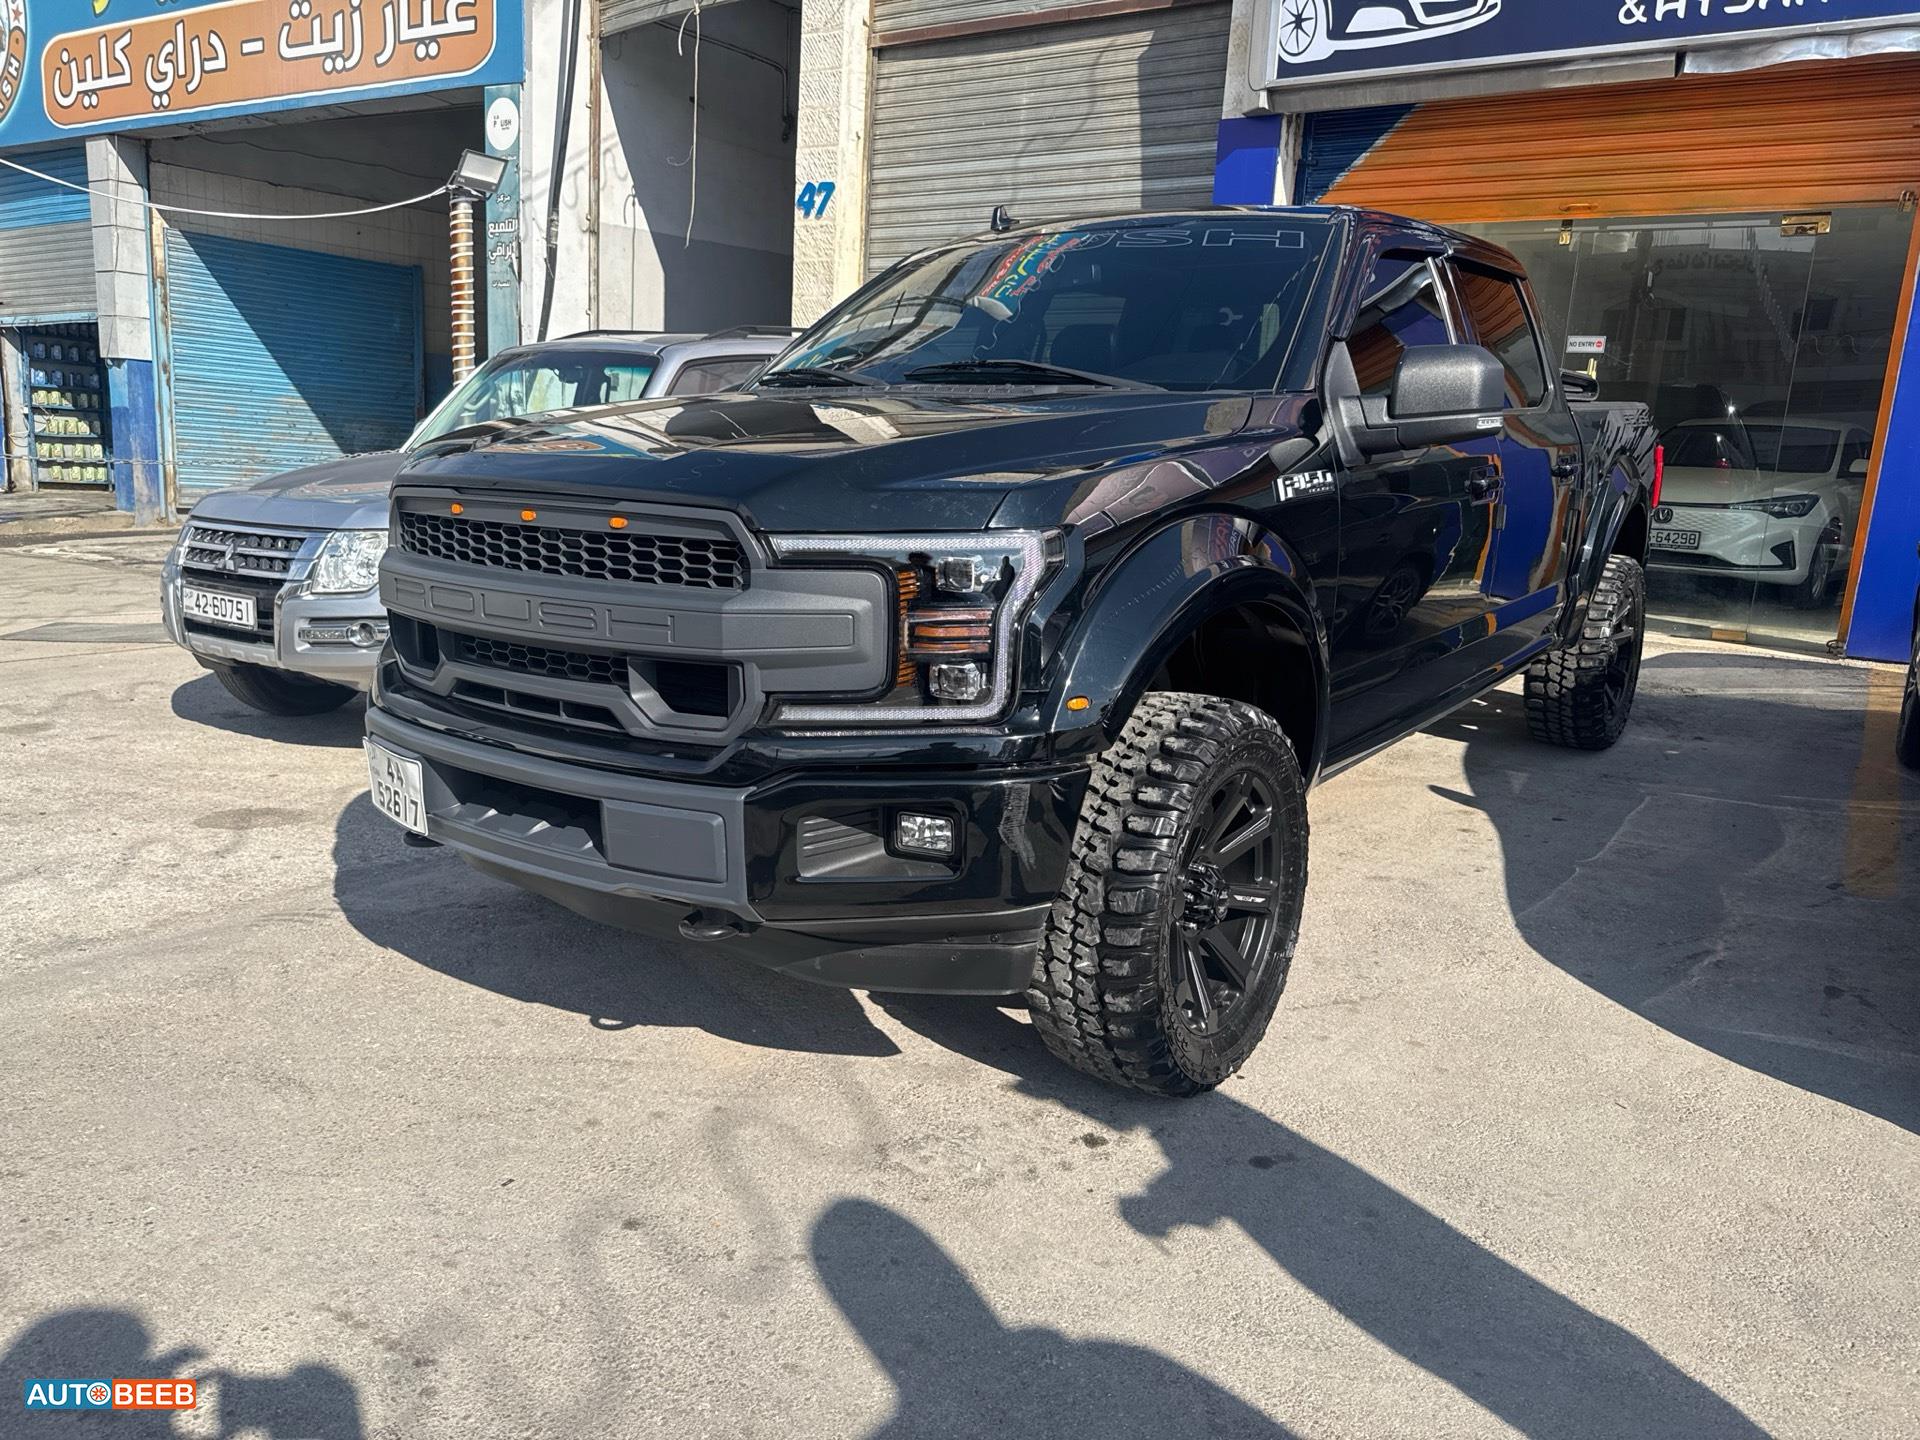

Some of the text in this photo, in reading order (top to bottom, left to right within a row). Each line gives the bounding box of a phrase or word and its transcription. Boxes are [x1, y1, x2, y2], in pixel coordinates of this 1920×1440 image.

[53, 28, 132, 109] كلين
[145, 19, 228, 109] دراي
[279, 0, 362, 74] زيت
[796, 182, 836, 219] 47
[378, 779, 418, 827] 52617
